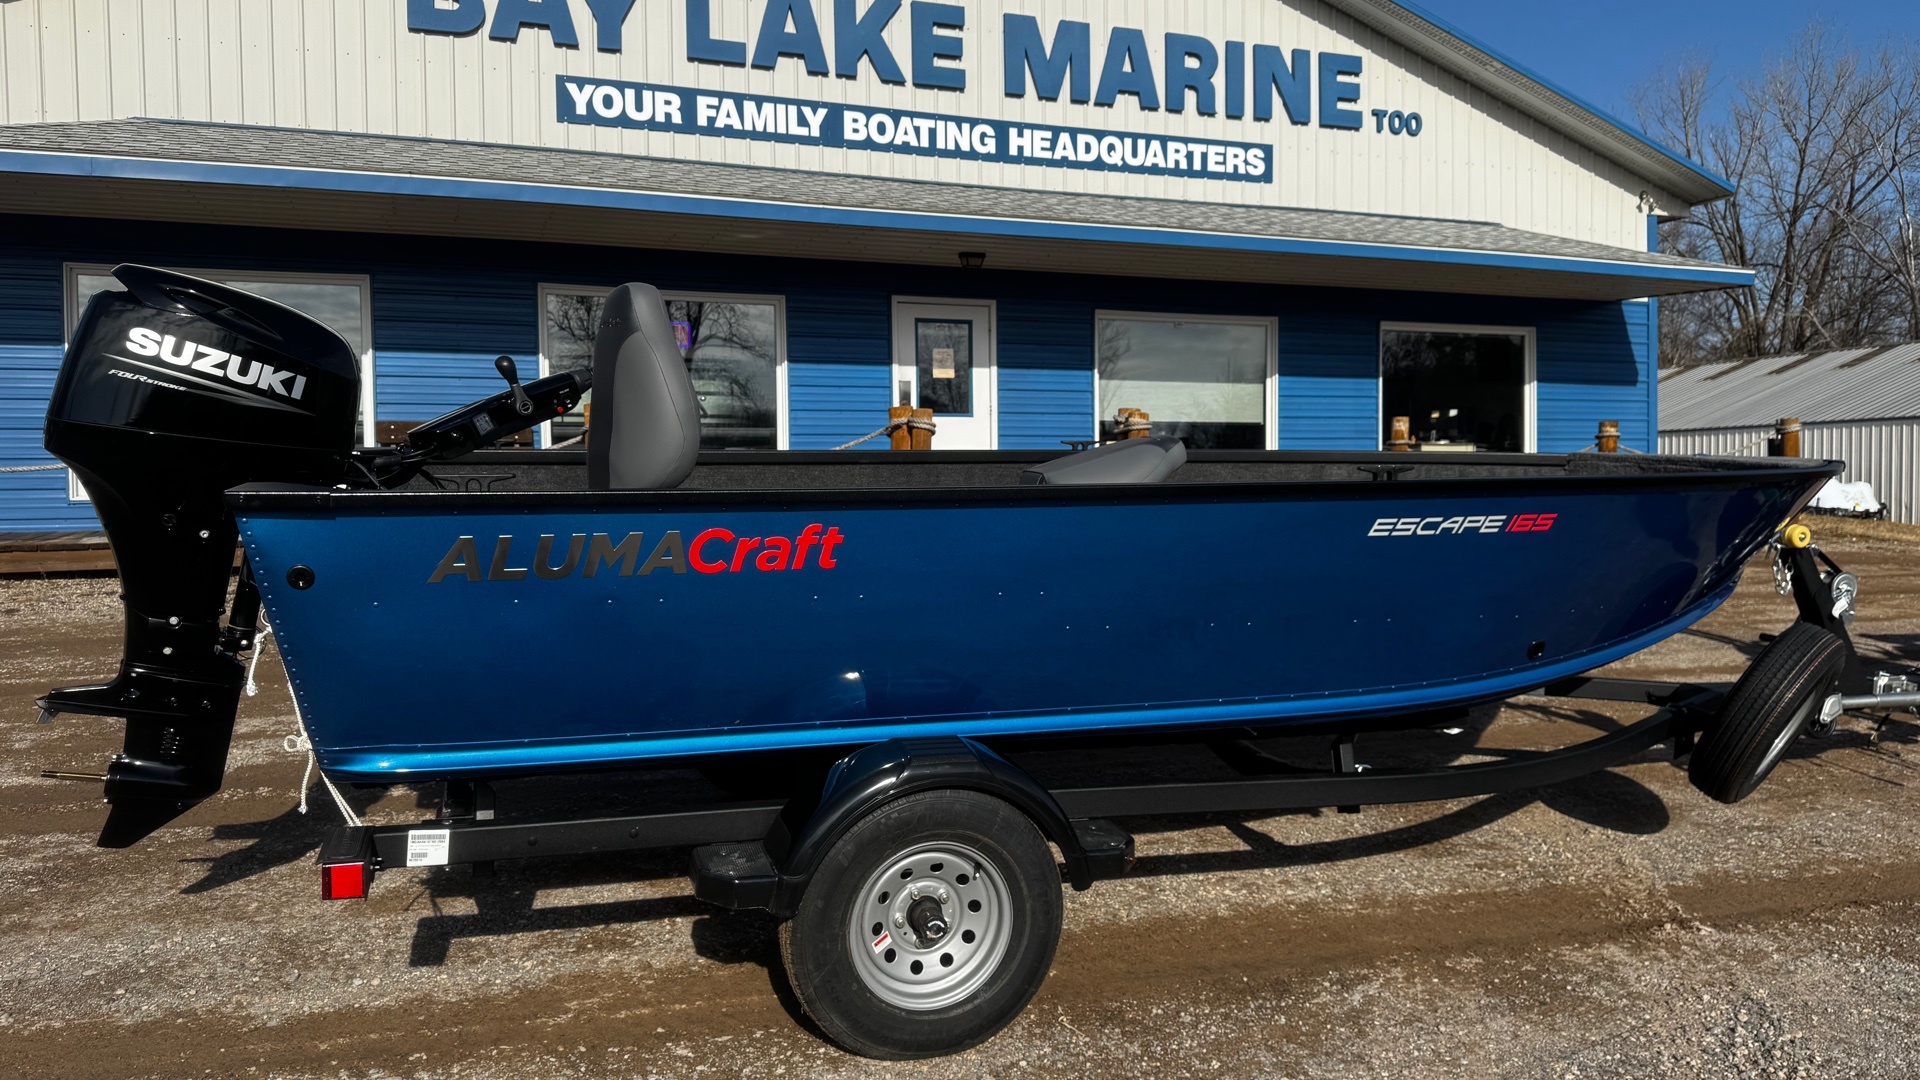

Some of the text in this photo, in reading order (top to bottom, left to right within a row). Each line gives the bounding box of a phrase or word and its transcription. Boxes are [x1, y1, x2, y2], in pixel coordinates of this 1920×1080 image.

[687, 0, 966, 89] LAKE
[1003, 13, 1363, 130] MARINE
[1372, 109, 1423, 137] TOO
[565, 82, 1267, 177] YOUR FAMILY BOATING HEADQUARTERS
[125, 327, 307, 400] SUZUKI
[427, 523, 844, 583] ALUMACraft
[1367, 515, 1507, 537] ESCAPE
